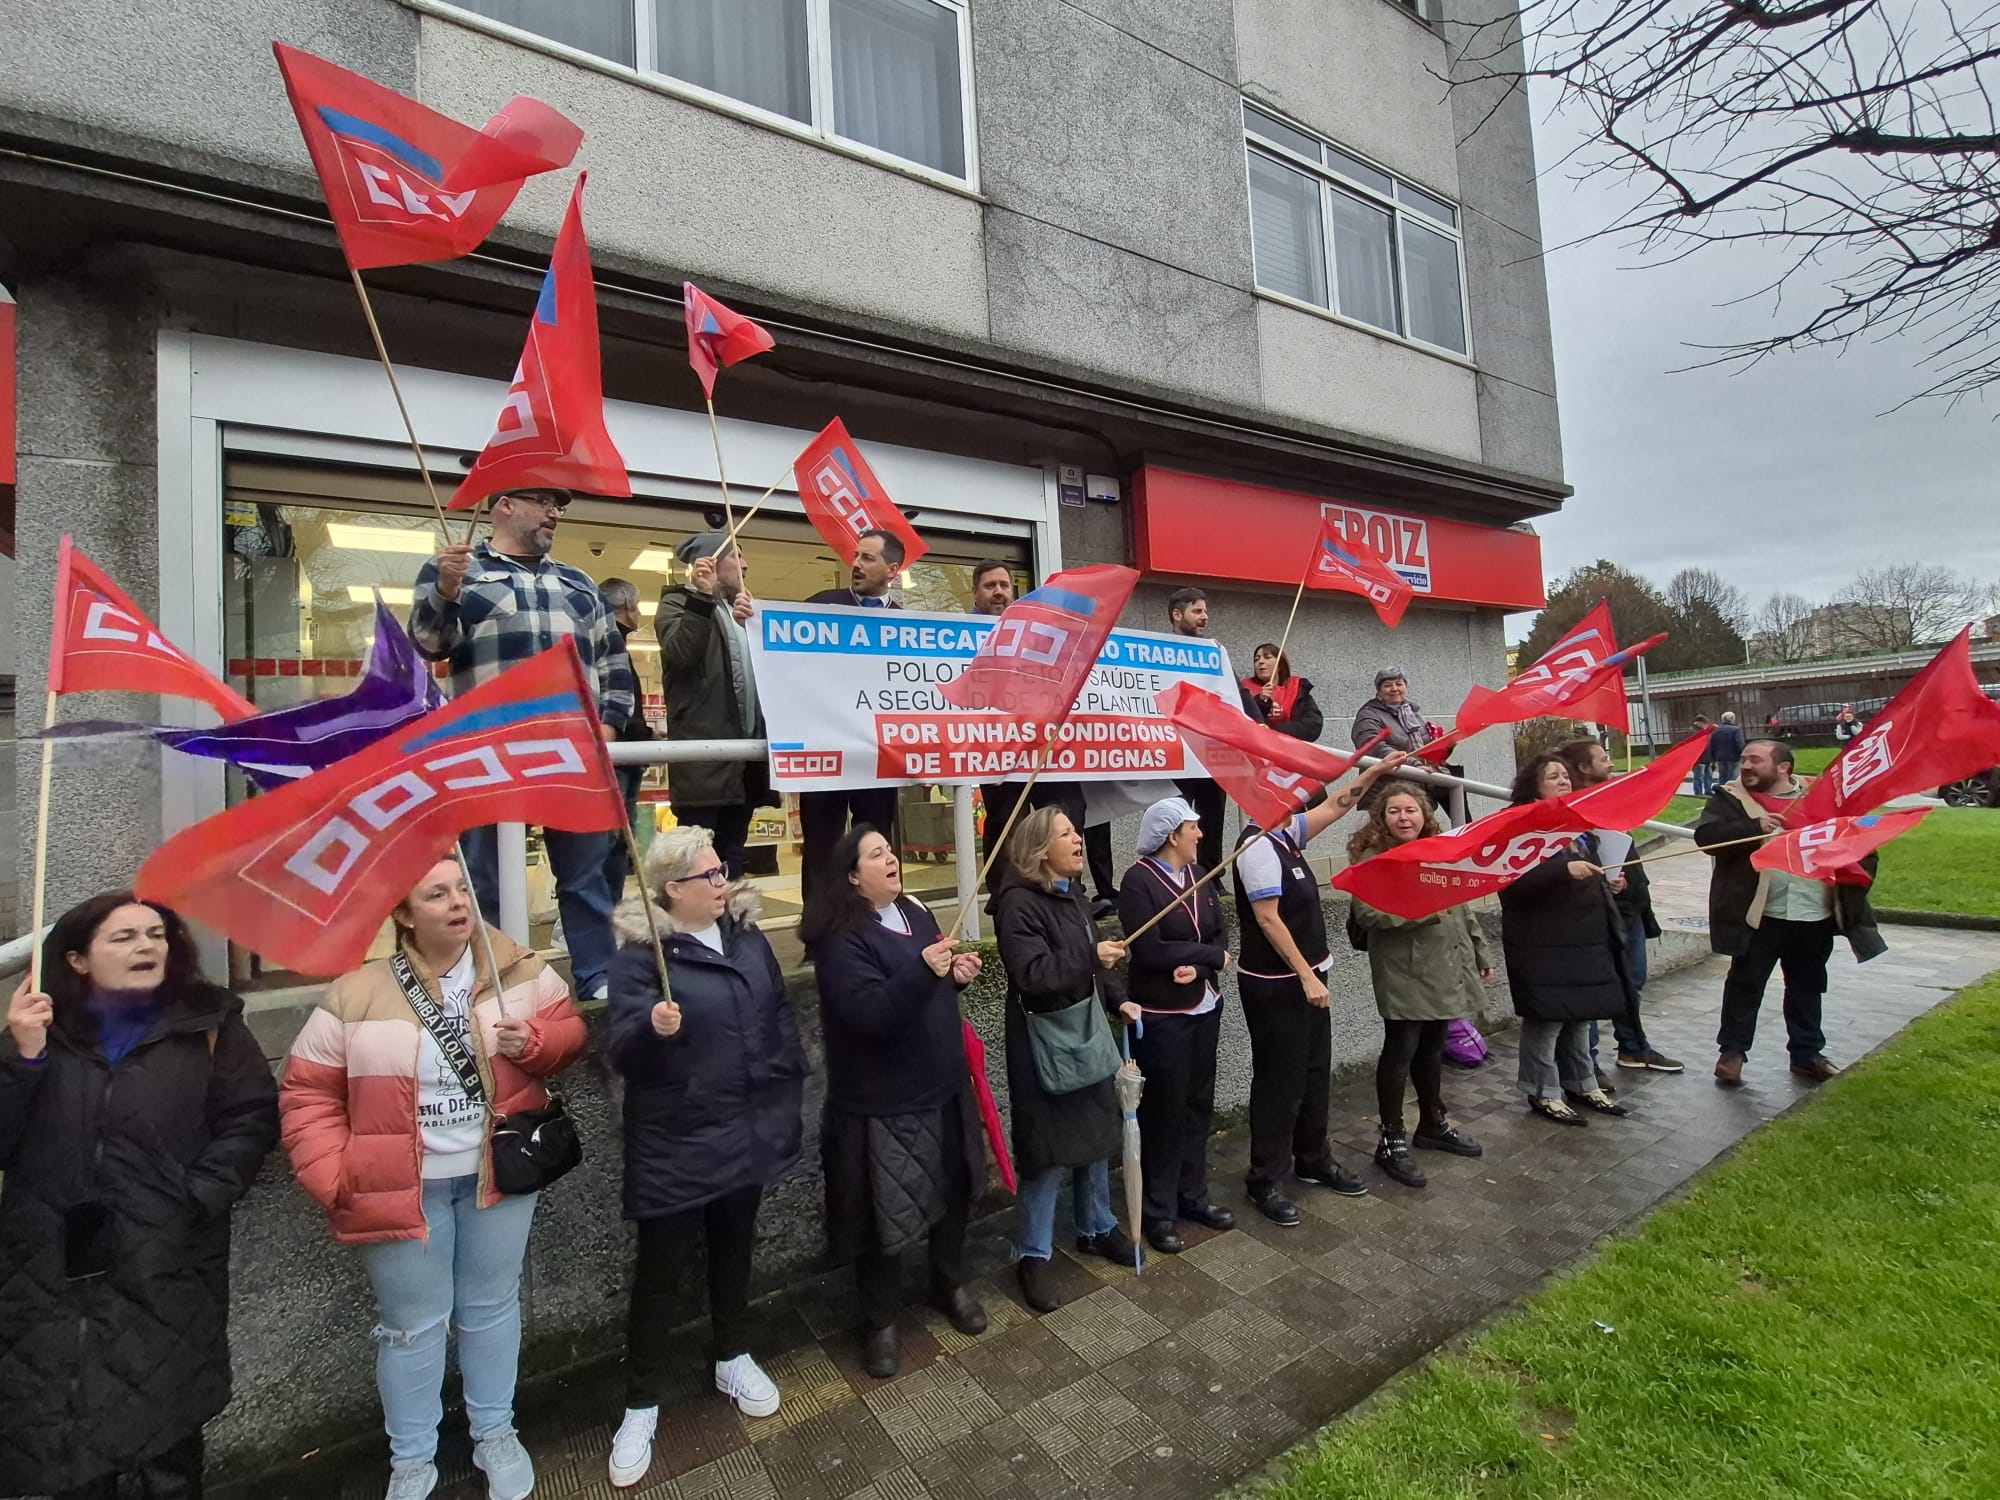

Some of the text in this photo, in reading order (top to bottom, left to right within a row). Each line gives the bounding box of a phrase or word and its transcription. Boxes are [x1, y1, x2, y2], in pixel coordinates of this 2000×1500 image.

[815, 466, 874, 537] CCO
[768, 618, 839, 646] NON
[849, 624, 871, 647] A
[1123, 642, 1220, 670] TRABALLO
[886, 661, 953, 683] POLO
[1089, 667, 1147, 691] SAÚDE
[1151, 674, 1161, 691] E
[855, 689, 873, 710] A
[882, 720, 1177, 744] POR UNHAS CONDICIÓNS
[774, 755, 838, 774] CCOO
[905, 749, 1167, 774] DE TRABALLO DIGNAS
[417, 1102, 444, 1116] ETIC
[417, 1112, 480, 1128] TABLISHED
